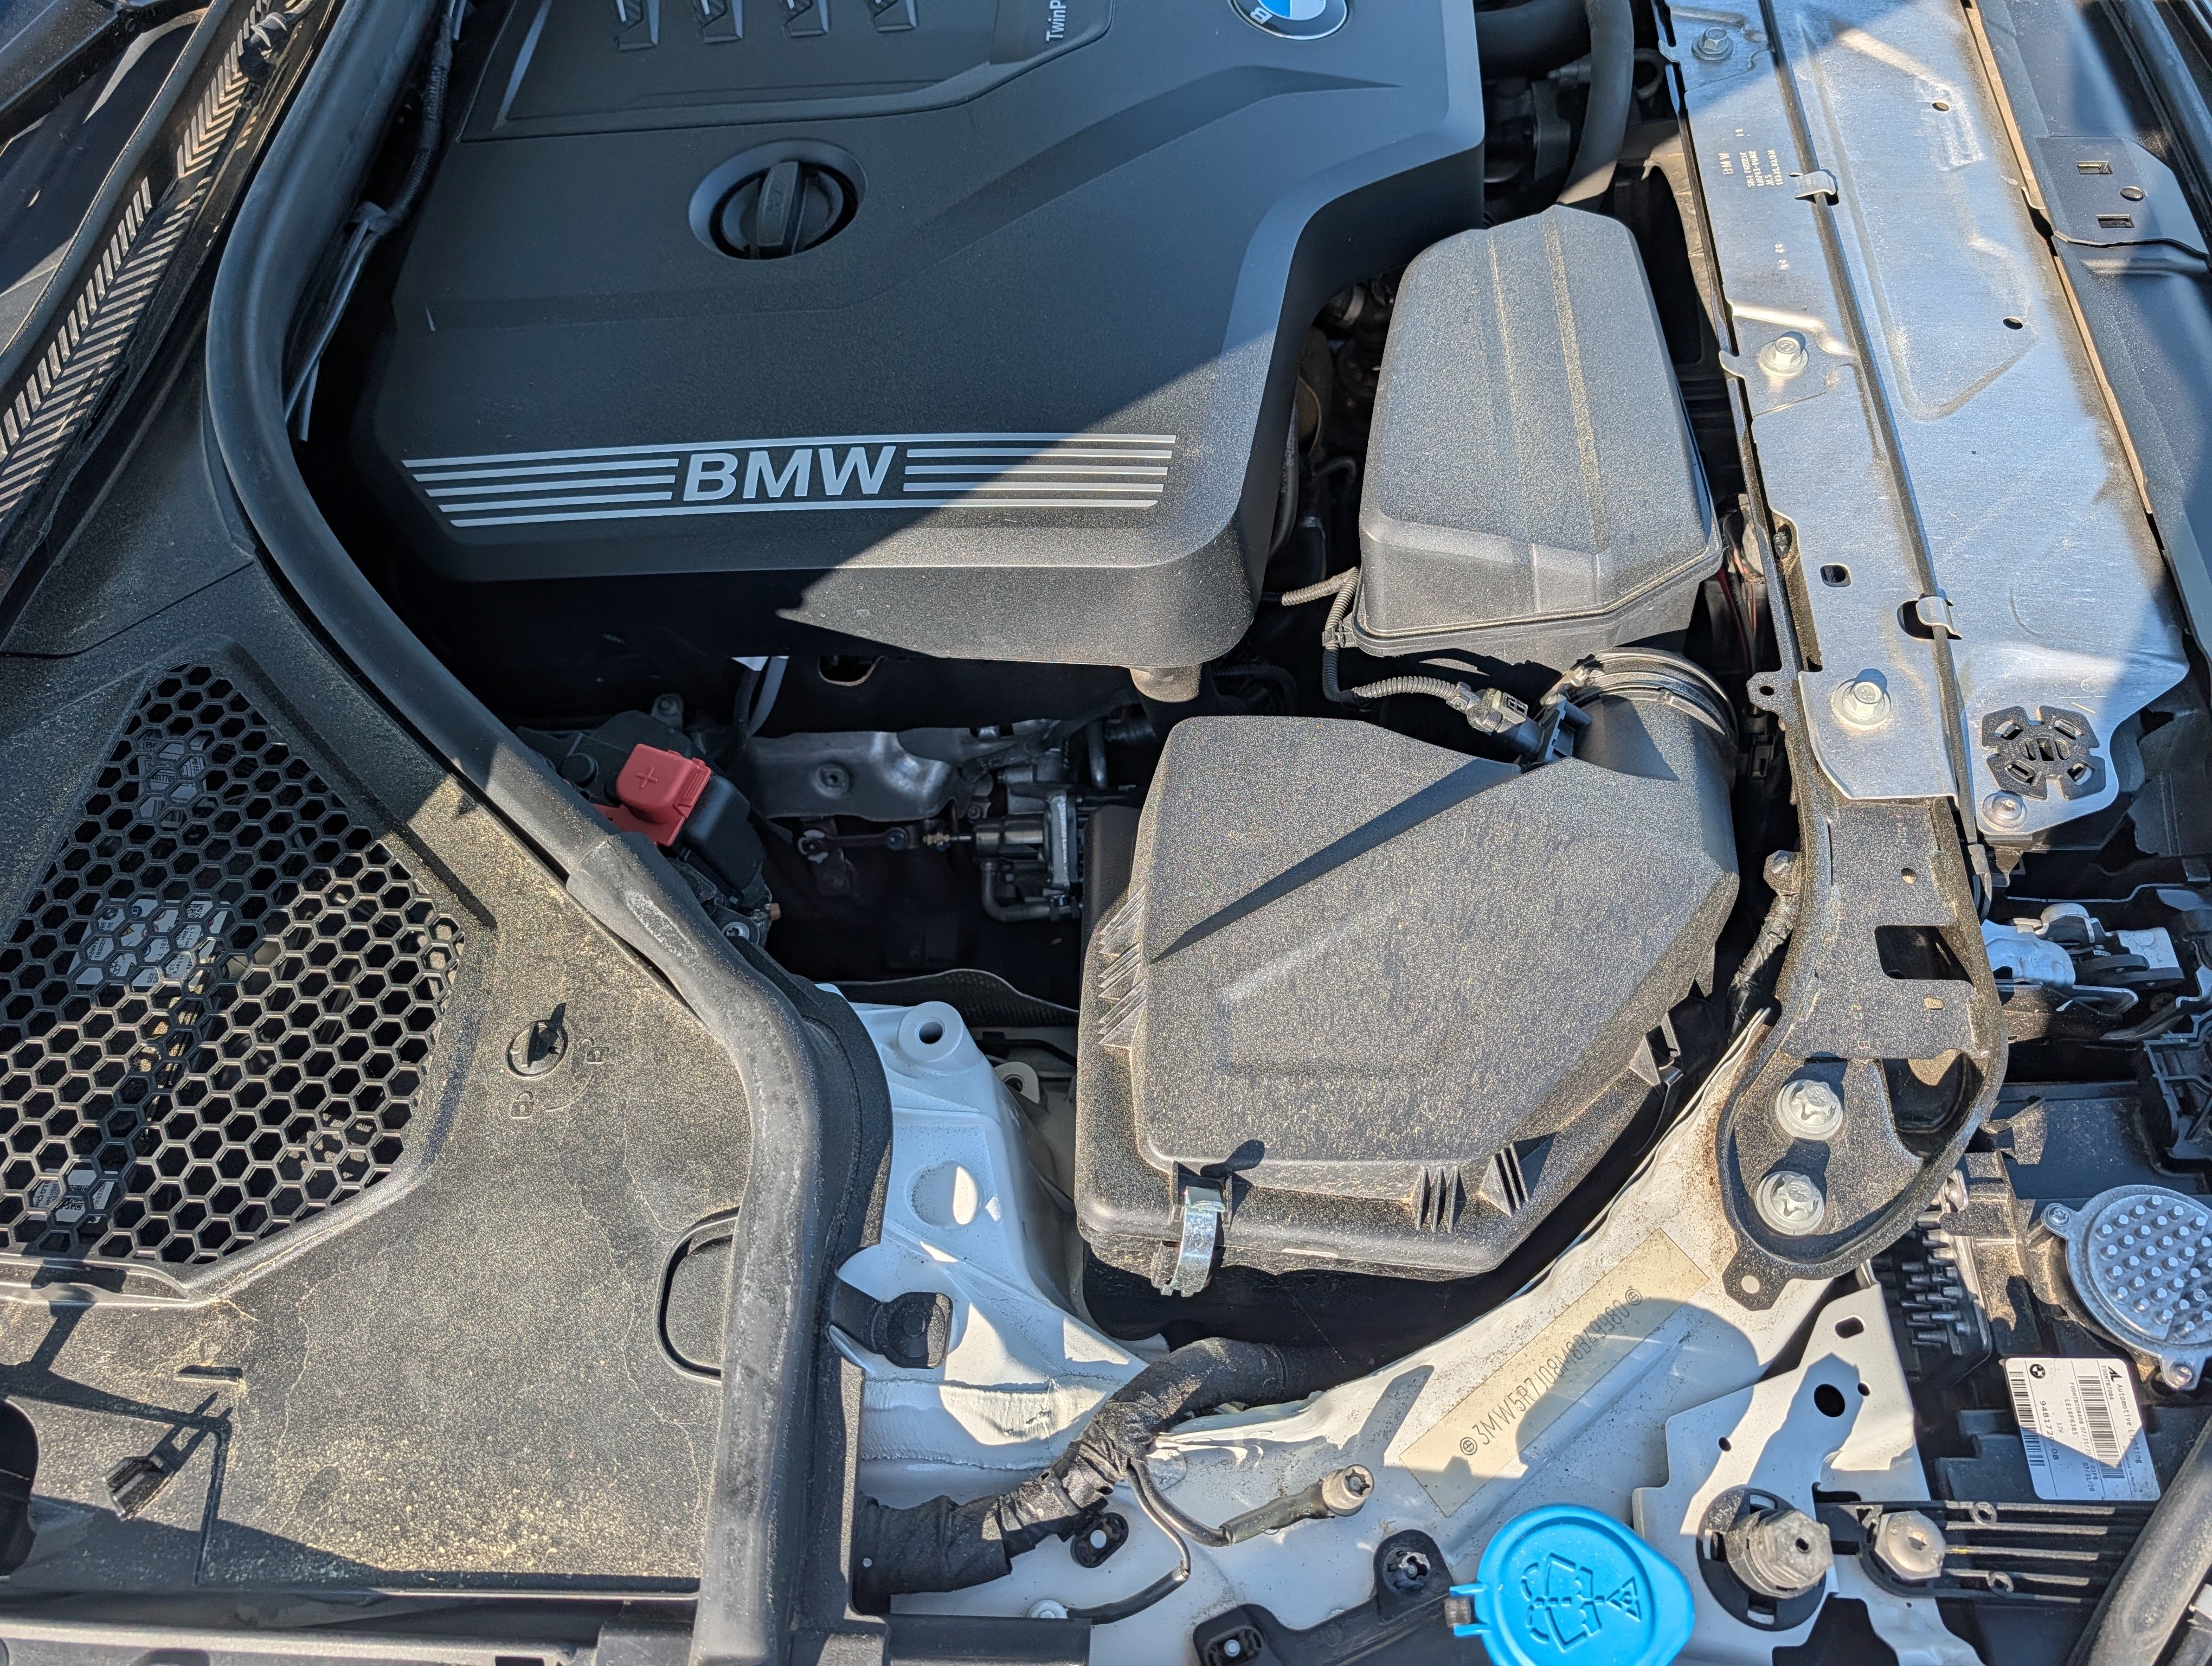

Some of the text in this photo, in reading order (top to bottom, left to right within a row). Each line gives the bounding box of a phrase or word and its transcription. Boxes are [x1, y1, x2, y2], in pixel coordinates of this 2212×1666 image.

[1045, 0, 1067, 42] TwinP
[1718, 152, 1734, 175] BMW
[683, 445, 896, 502] BMW
[40, 1185, 49, 1194] LG
[1471, 1299, 1630, 1445] 3MW5R7J08M8B49980
[2064, 1398, 2079, 1436] LE16F6385
[2116, 1383, 2132, 1427] Automotive
[2056, 1421, 2064, 1434] 12V
[2080, 1426, 2093, 1463] 07/31/200
